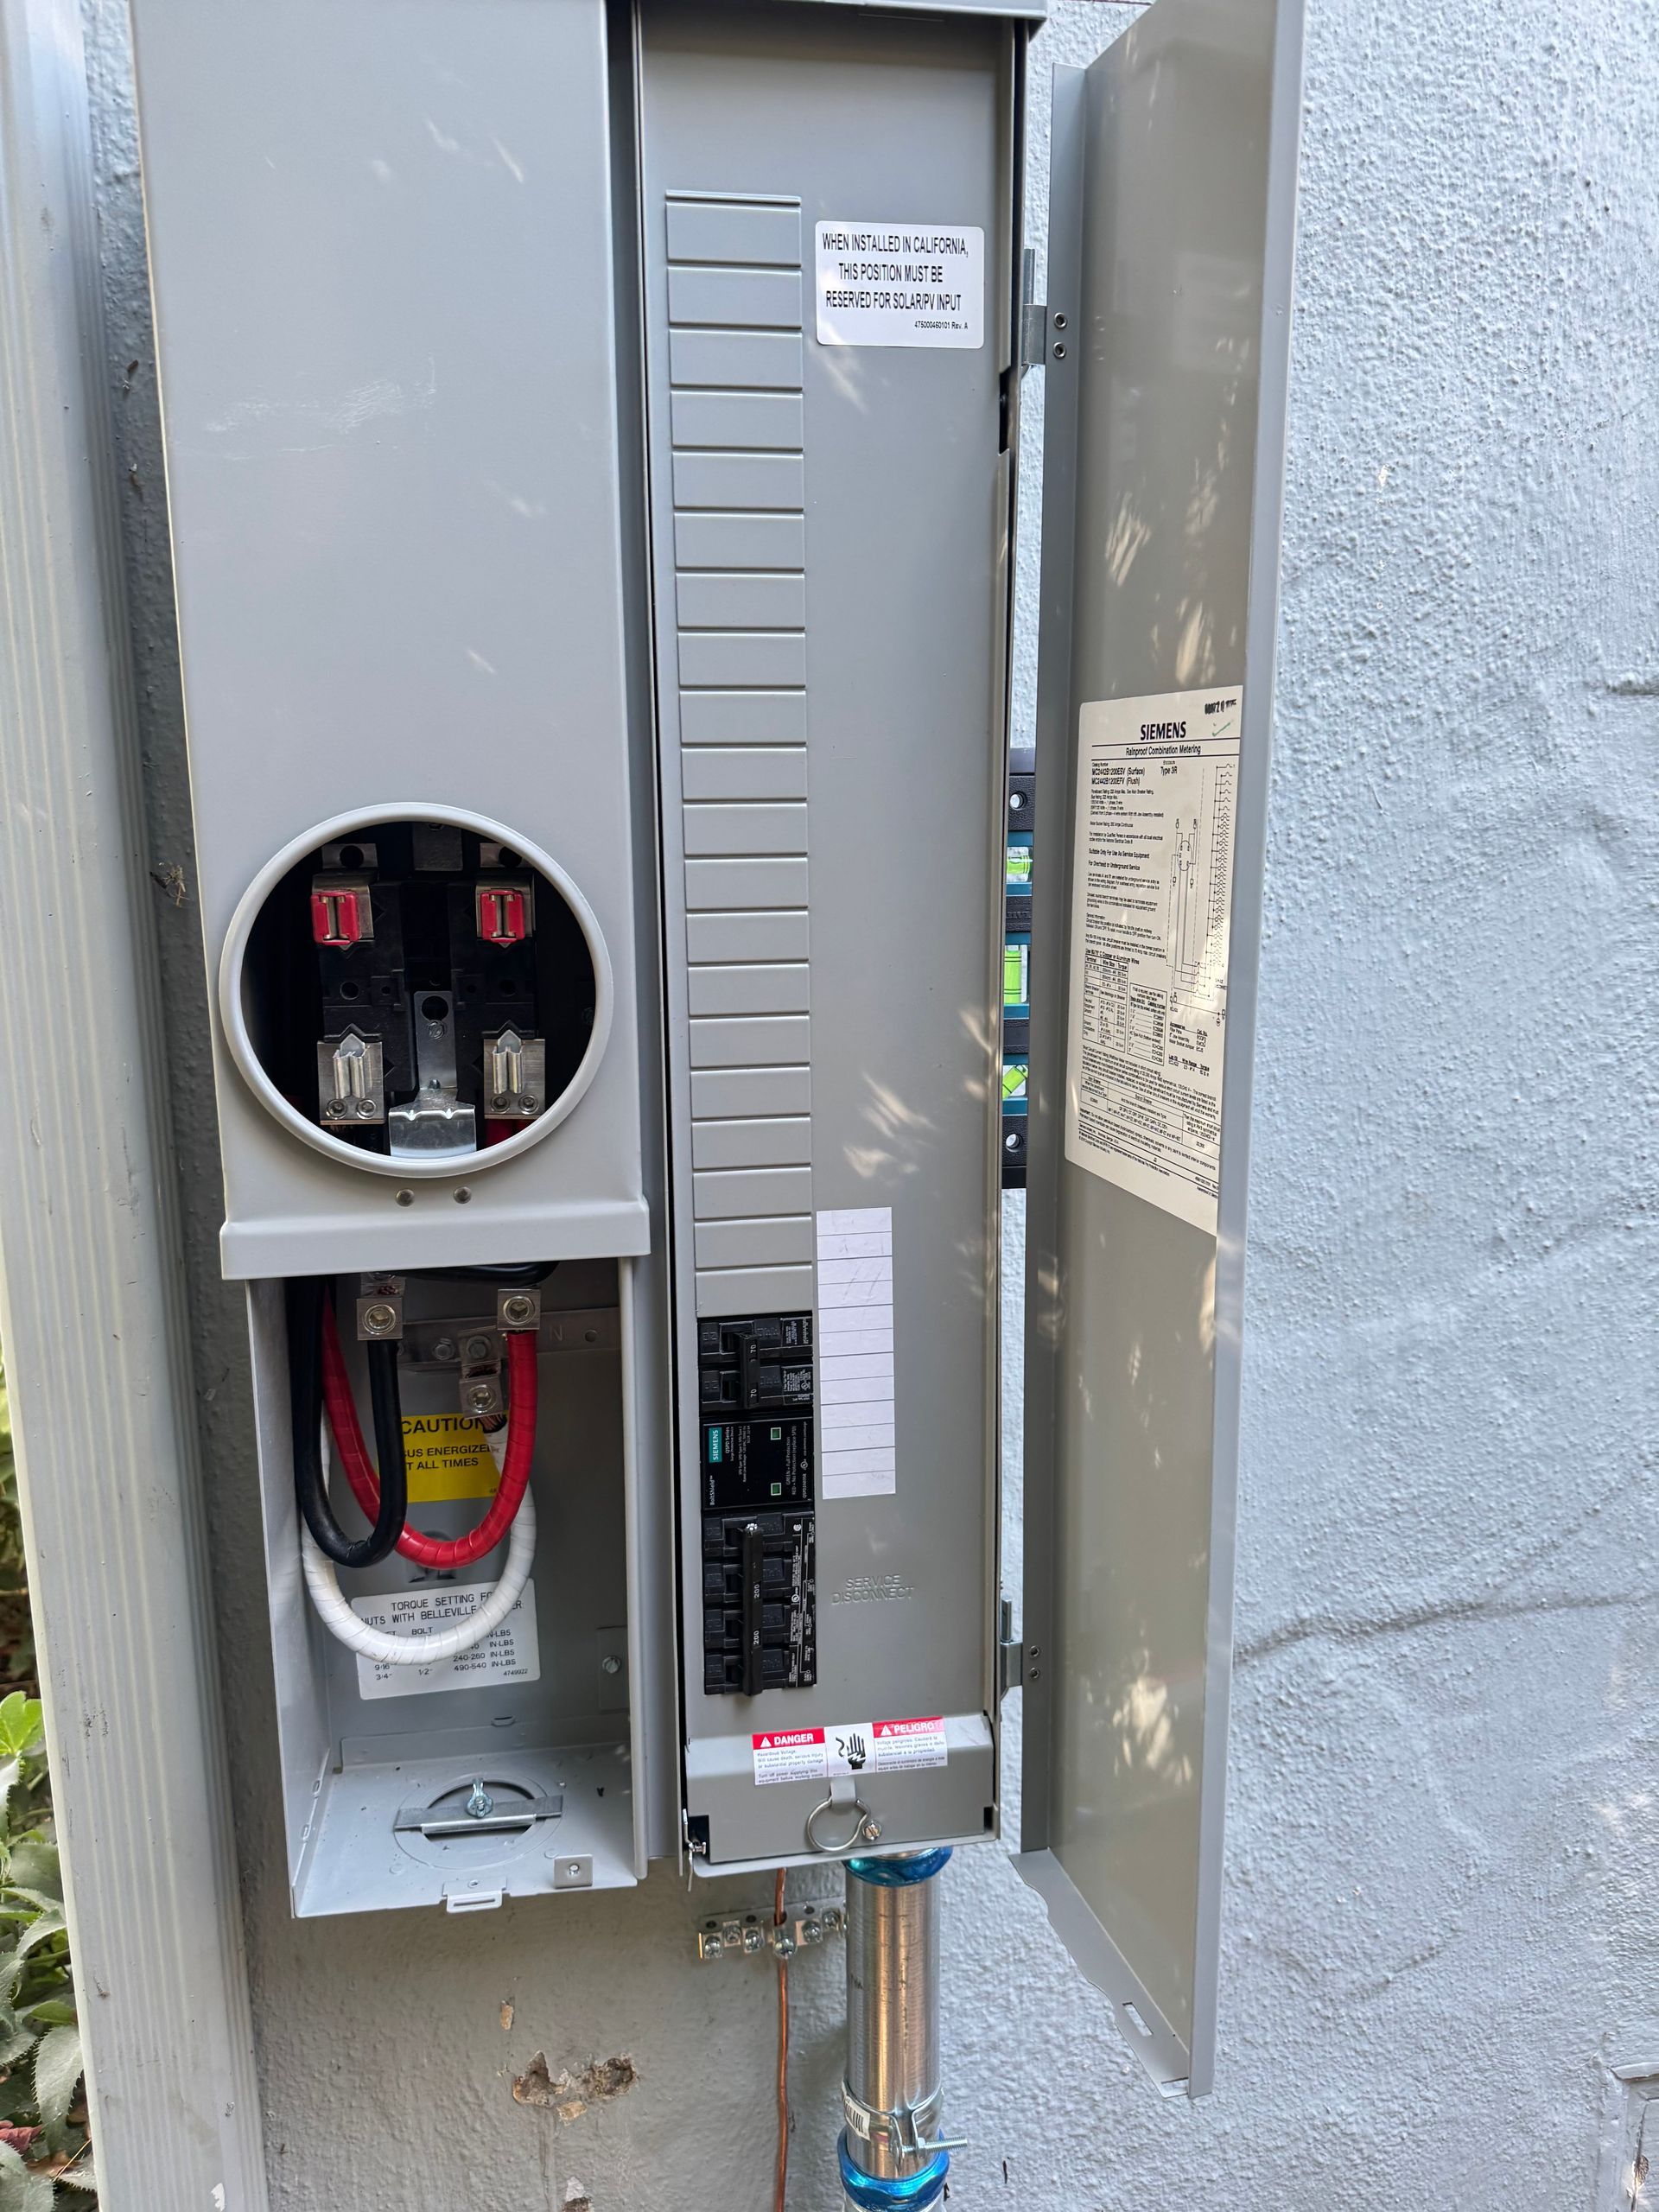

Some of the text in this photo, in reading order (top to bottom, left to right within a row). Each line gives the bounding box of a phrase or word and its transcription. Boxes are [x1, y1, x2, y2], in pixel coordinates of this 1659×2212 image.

[823, 233, 969, 257] WHEN INSTALLED IN CALIFORNIA,
[839, 263, 943, 283] THIS POSITION MUST BE
[826, 290, 961, 311] RESERVED FOR SOLAR/PV INPUT
[1141, 721, 1186, 741] SIEMENS
[1126, 745, 1201, 757] Rainproof Combination Metering
[1127, 767, 1145, 776] (Surface)
[1160, 766, 1170, 776] Type
[1127, 778, 1140, 786] (Flush)
[750, 1344, 757, 1354] 70
[750, 1389, 757, 1398] 70
[404, 1448, 423, 1458] US
[416, 1457, 479, 1470] ALL TIMES
[847, 1574, 899, 1590] SERVICE
[831, 1586, 914, 1605] DISCONNECT
[391, 1599, 429, 1611] TORQUE
[435, 1593, 475, 1606] SETTING
[392, 1612, 415, 1624] WITH
[422, 1605, 477, 1620] BELLEVILLE
[411, 1626, 434, 1636] BOLT
[489, 1639, 514, 1648] IN-LBS
[453, 1649, 515, 1662] 240-260 IN-LBS
[454, 1662, 486, 1672] 490-540
[491, 1659, 517, 1668] IN-LBS
[893, 1722, 934, 1734] PELIGRO
[774, 1733, 814, 1745] DANGER
